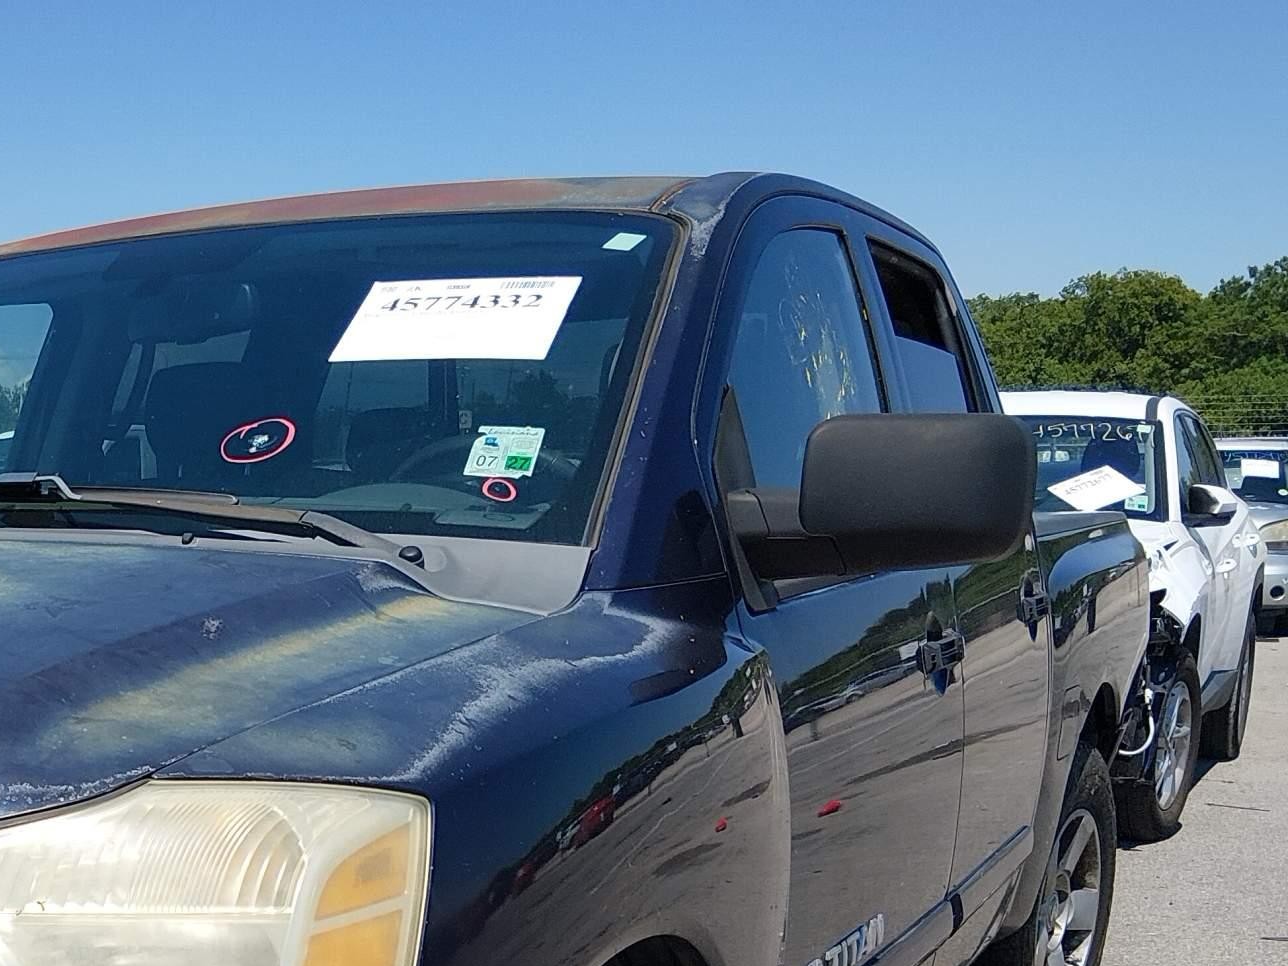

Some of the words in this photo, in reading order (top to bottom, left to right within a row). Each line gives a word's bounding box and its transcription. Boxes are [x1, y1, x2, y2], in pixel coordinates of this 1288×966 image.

[381, 294, 543, 311] 45774332
[476, 455, 499, 467] 07
[508, 457, 530, 471] 27
